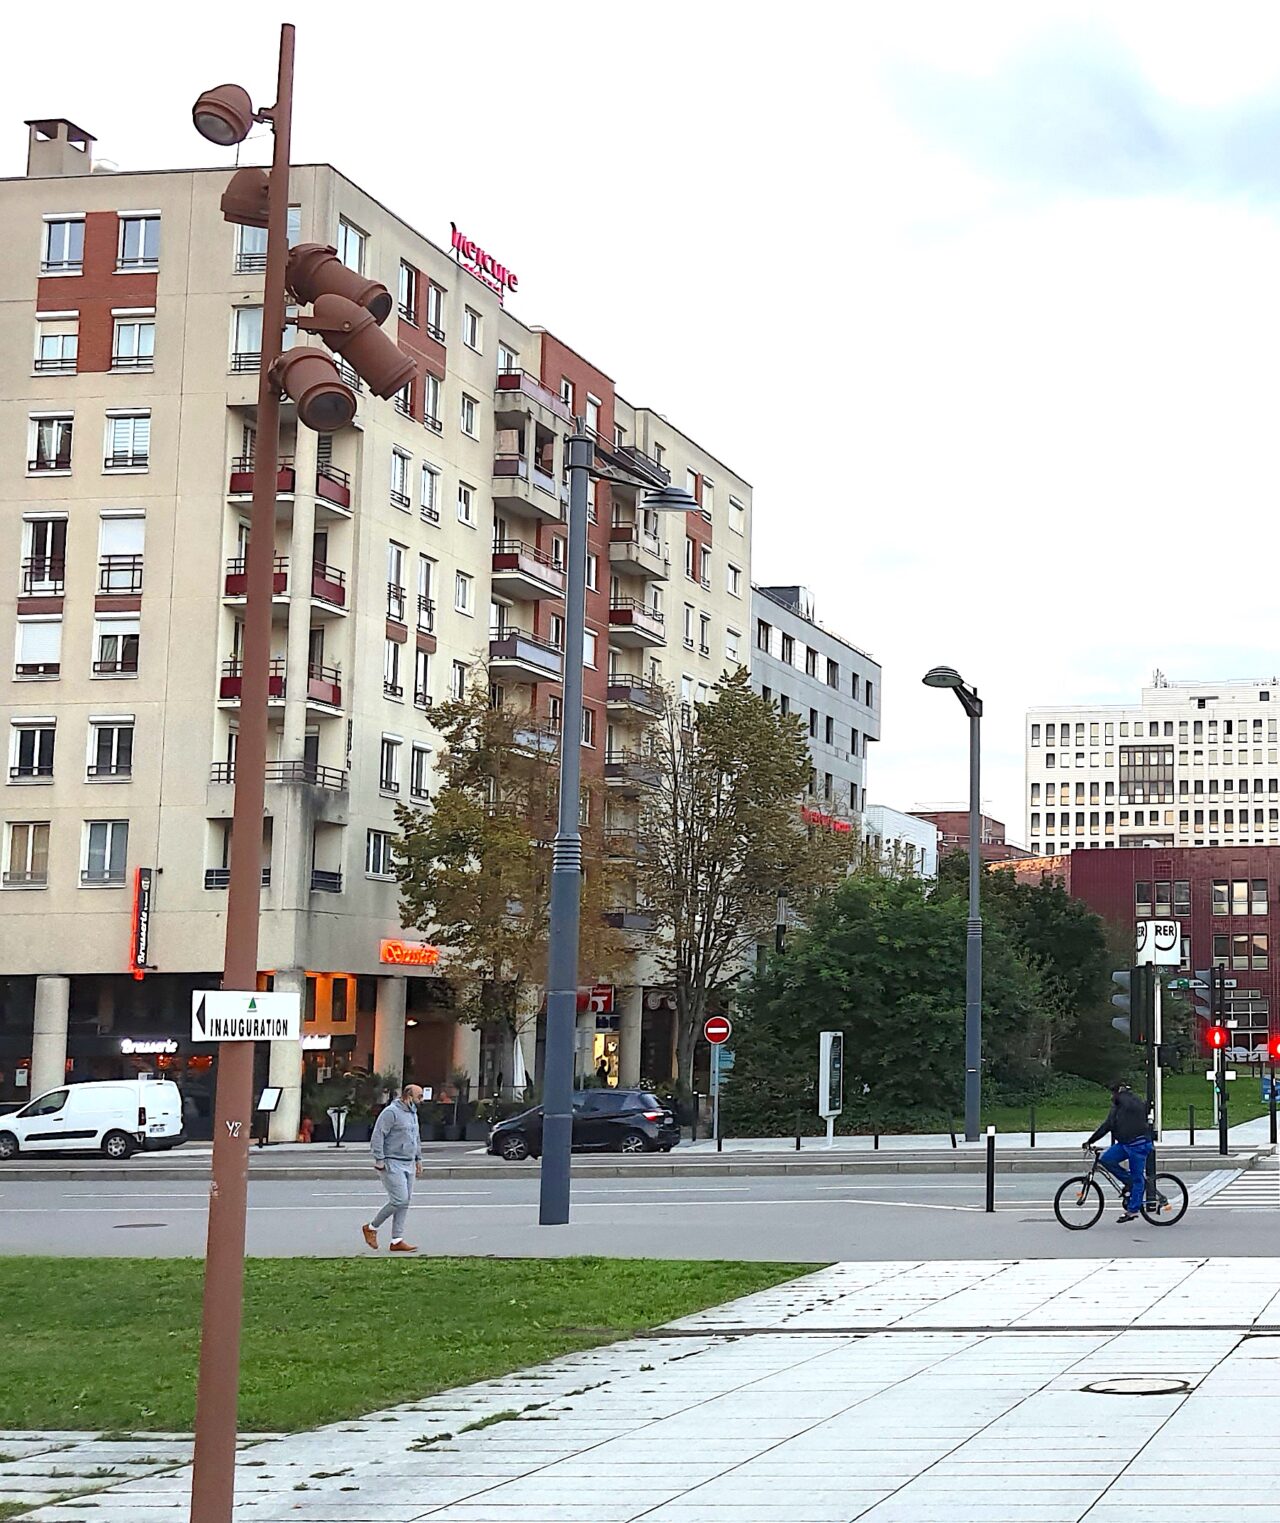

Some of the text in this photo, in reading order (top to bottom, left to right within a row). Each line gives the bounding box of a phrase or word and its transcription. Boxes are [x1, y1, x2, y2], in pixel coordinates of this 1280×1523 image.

[137, 911, 149, 965] Brasserie
[1154, 924, 1175, 937] RER
[210, 1018, 288, 1037] INAUGURATION
